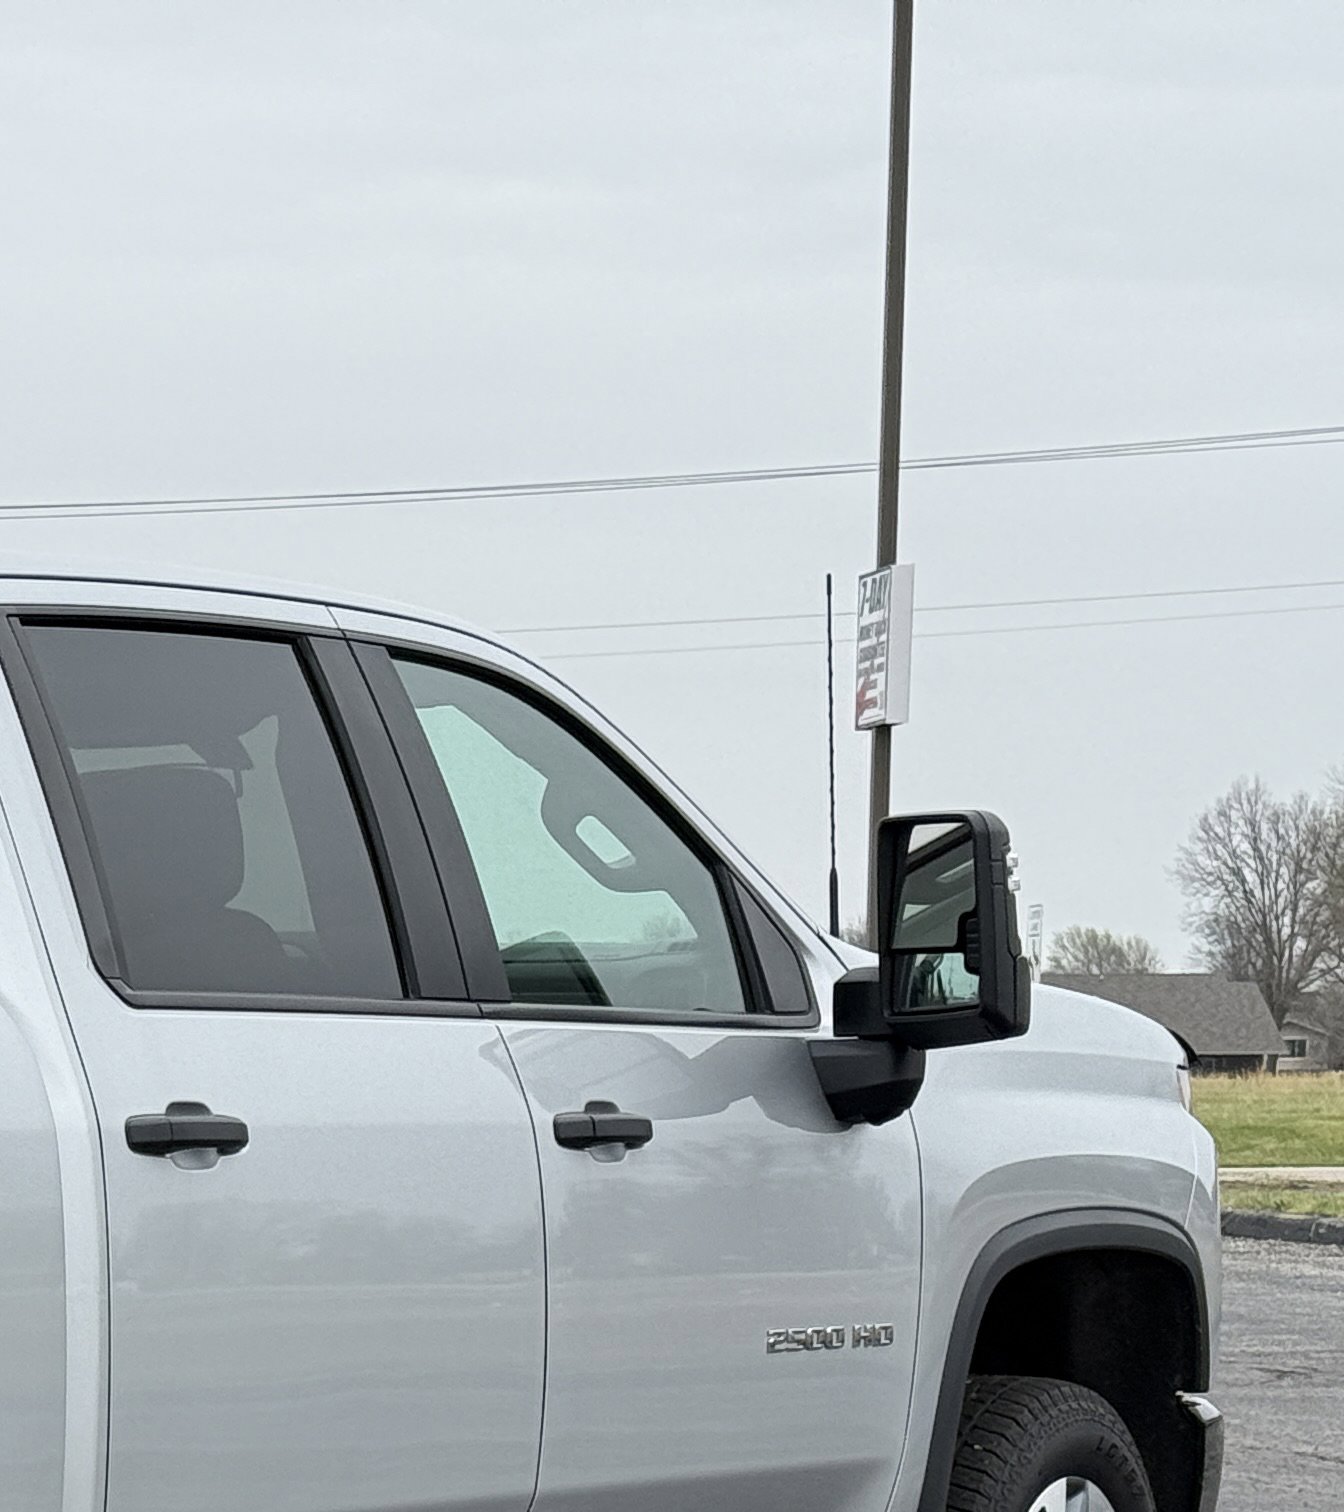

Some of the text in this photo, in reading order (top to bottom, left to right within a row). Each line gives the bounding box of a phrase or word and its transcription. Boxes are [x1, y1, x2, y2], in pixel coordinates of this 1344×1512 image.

[861, 573, 889, 617] 7-DAY
[767, 1322, 894, 1354] 2500 HD
